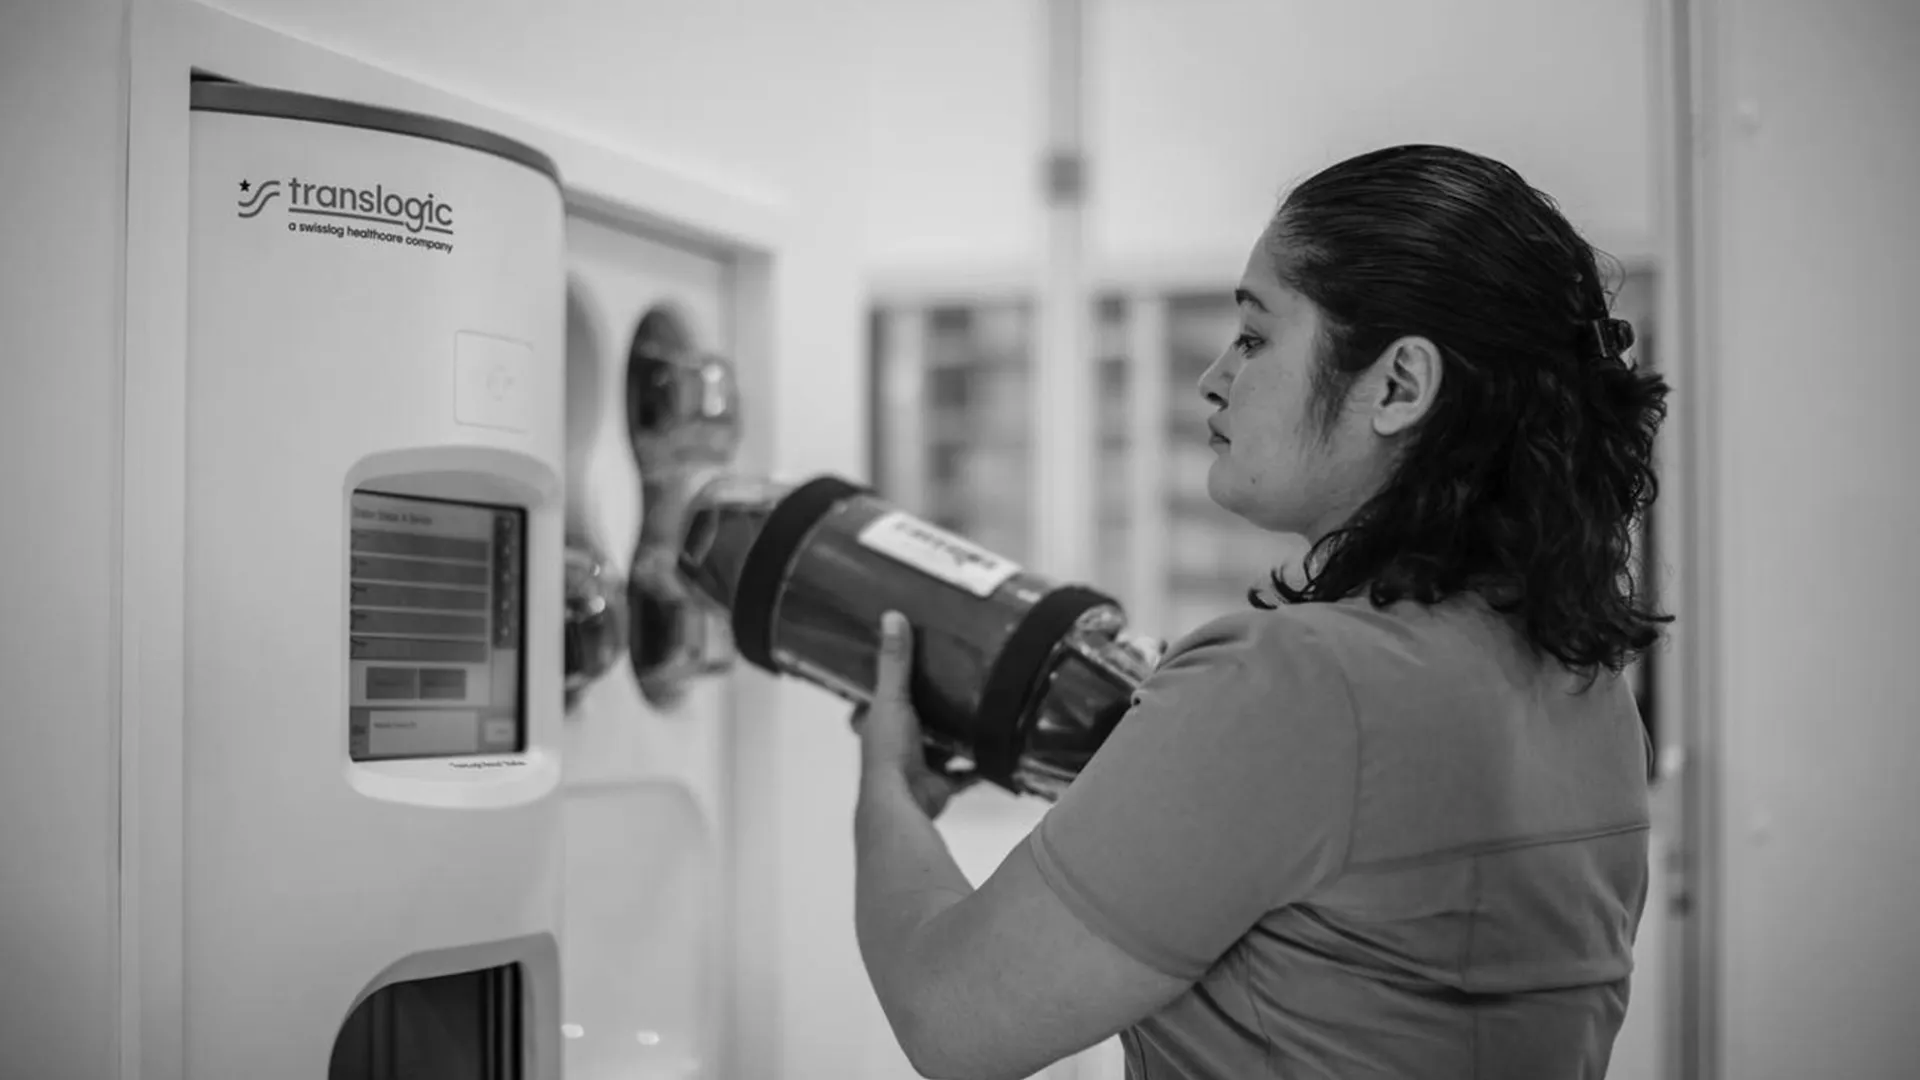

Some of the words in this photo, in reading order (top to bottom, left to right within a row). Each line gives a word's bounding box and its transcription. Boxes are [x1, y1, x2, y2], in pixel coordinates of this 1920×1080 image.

[288, 177, 453, 232] translogic
[288, 222, 297, 232] a
[299, 222, 344, 239] swisslog
[346, 225, 404, 244] healthcare
[405, 235, 453, 254] company
